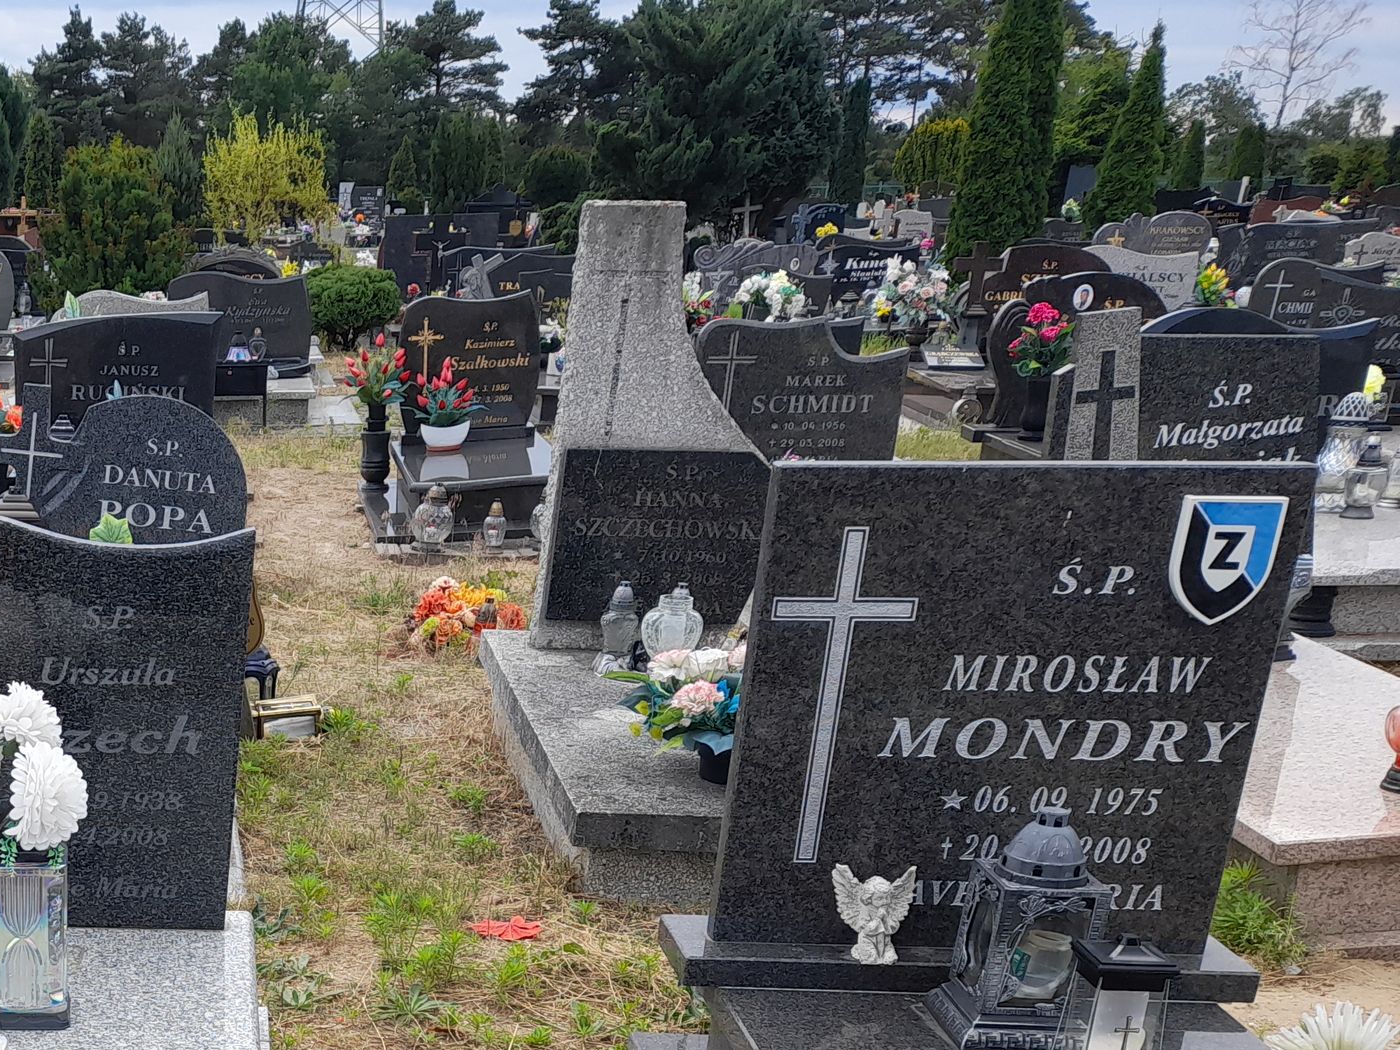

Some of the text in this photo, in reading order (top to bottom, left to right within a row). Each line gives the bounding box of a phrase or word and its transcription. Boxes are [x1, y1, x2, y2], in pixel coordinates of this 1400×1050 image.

[844, 257, 887, 270] Kune
[464, 337, 516, 351] Kazimierz
[100, 364, 160, 377] JANUSZ
[450, 352, 531, 371] Szałkowski
[785, 374, 848, 387] MAREK
[1208, 379, 1254, 409] Ś.P.
[751, 394, 874, 415] SCHMIDT
[818, 438, 846, 447] 2008
[1153, 415, 1305, 449] Małgorzata
[103, 464, 216, 494] DANUTA
[633, 490, 729, 508] HANNA
[98, 499, 214, 534] POPA
[574, 518, 762, 541] SZCZECHOWSK
[1207, 531, 1248, 570] Z
[1052, 556, 1137, 596] Ś.P.
[41, 656, 176, 686] Urszula
[941, 653, 1213, 694] MIROSŁAW
[63, 714, 200, 756] zech
[877, 716, 1251, 763] MONDRY
[1087, 787, 1164, 816] 1975
[1107, 884, 1163, 912] RIA
